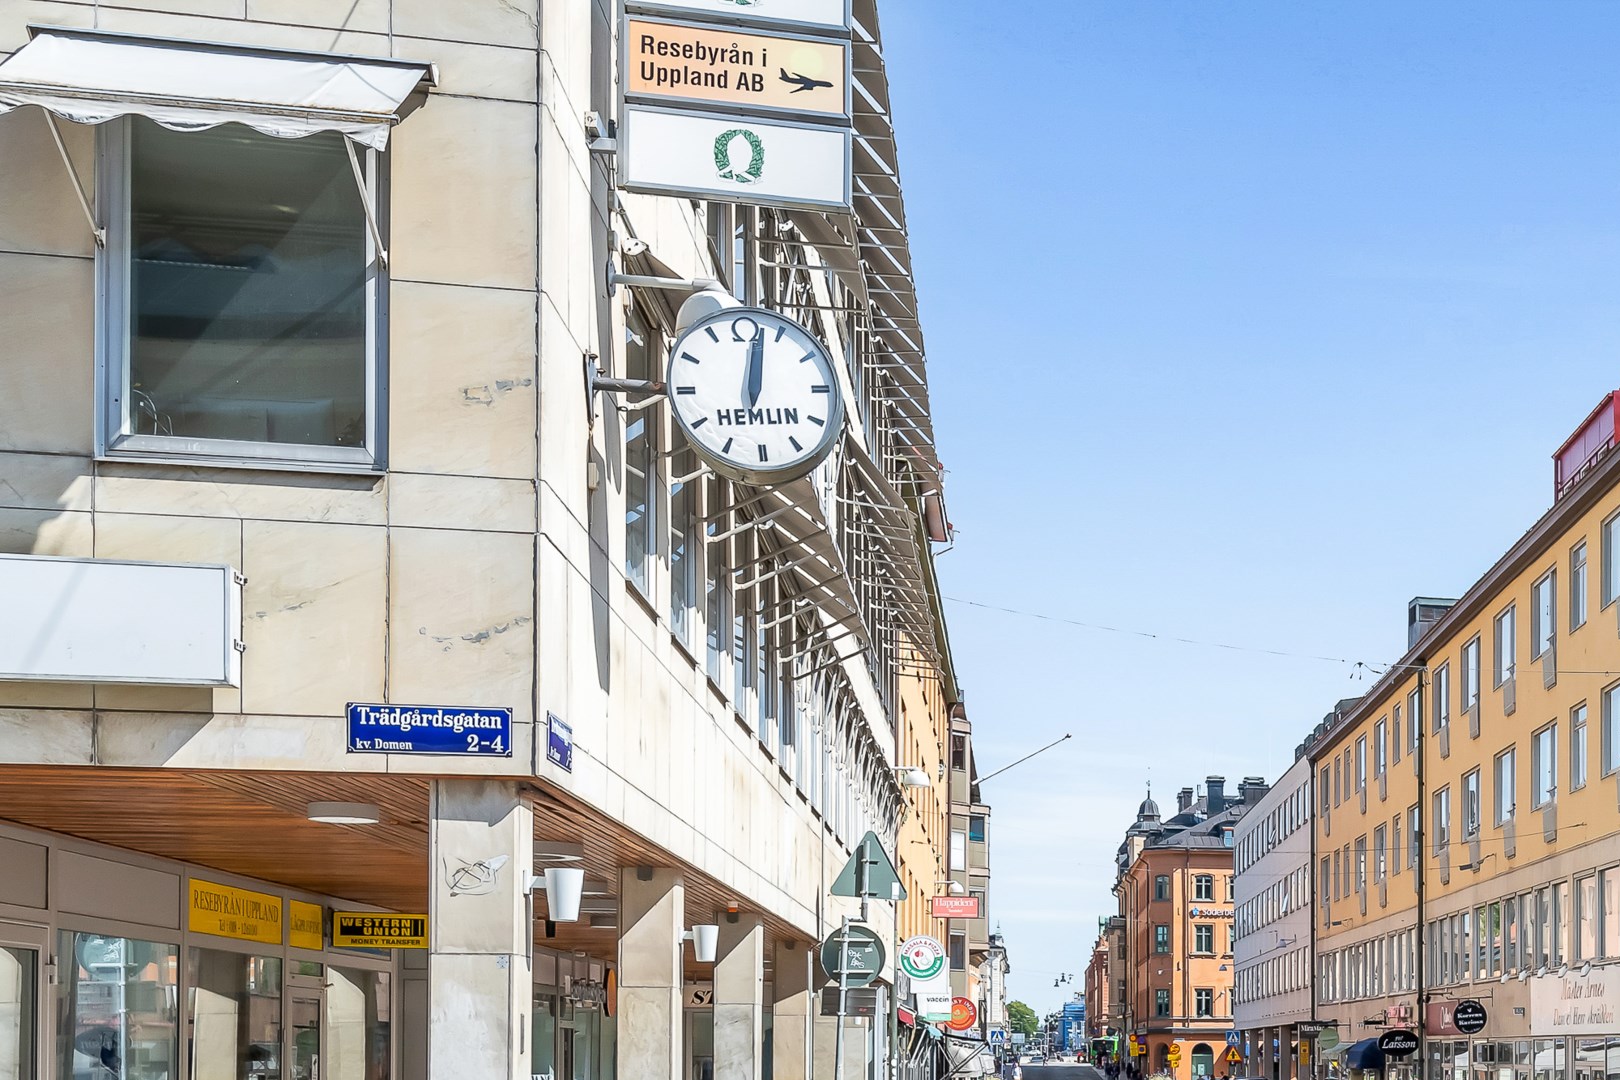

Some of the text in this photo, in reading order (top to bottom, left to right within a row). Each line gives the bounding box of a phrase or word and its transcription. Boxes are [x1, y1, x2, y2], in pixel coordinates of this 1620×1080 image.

[640, 34, 768, 68] Resebyrån i
[640, 61, 765, 94] Uppland AB
[716, 407, 799, 426] HEMLIN
[357, 706, 503, 732] Trädgårdsgatan
[355, 733, 504, 753] kv. Domen 2-4
[341, 917, 411, 928] WESTERN
[363, 926, 411, 936] UNION
[381, 938, 421, 946] TRANSFER
[904, 940, 923, 955] MASALA
[928, 941, 941, 956] PIZZA
[1381, 1039, 1416, 1049] Larsson
